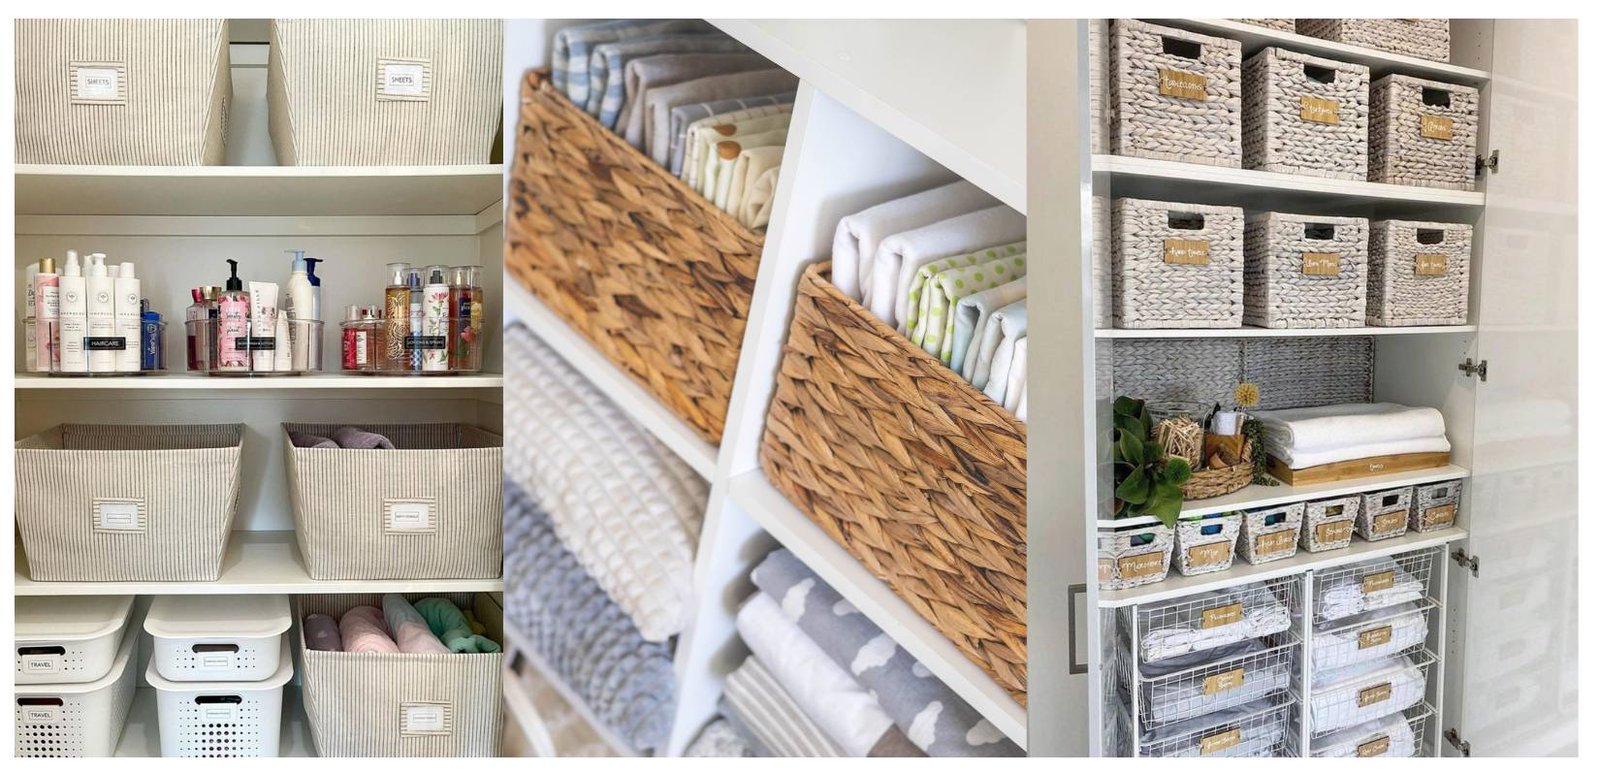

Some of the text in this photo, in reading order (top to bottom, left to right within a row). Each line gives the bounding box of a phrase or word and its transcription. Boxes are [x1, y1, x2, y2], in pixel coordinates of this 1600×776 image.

[86, 78, 110, 86] SHEETS
[391, 76, 413, 84] SHEETS
[91, 339, 120, 347] HAIRCARE
